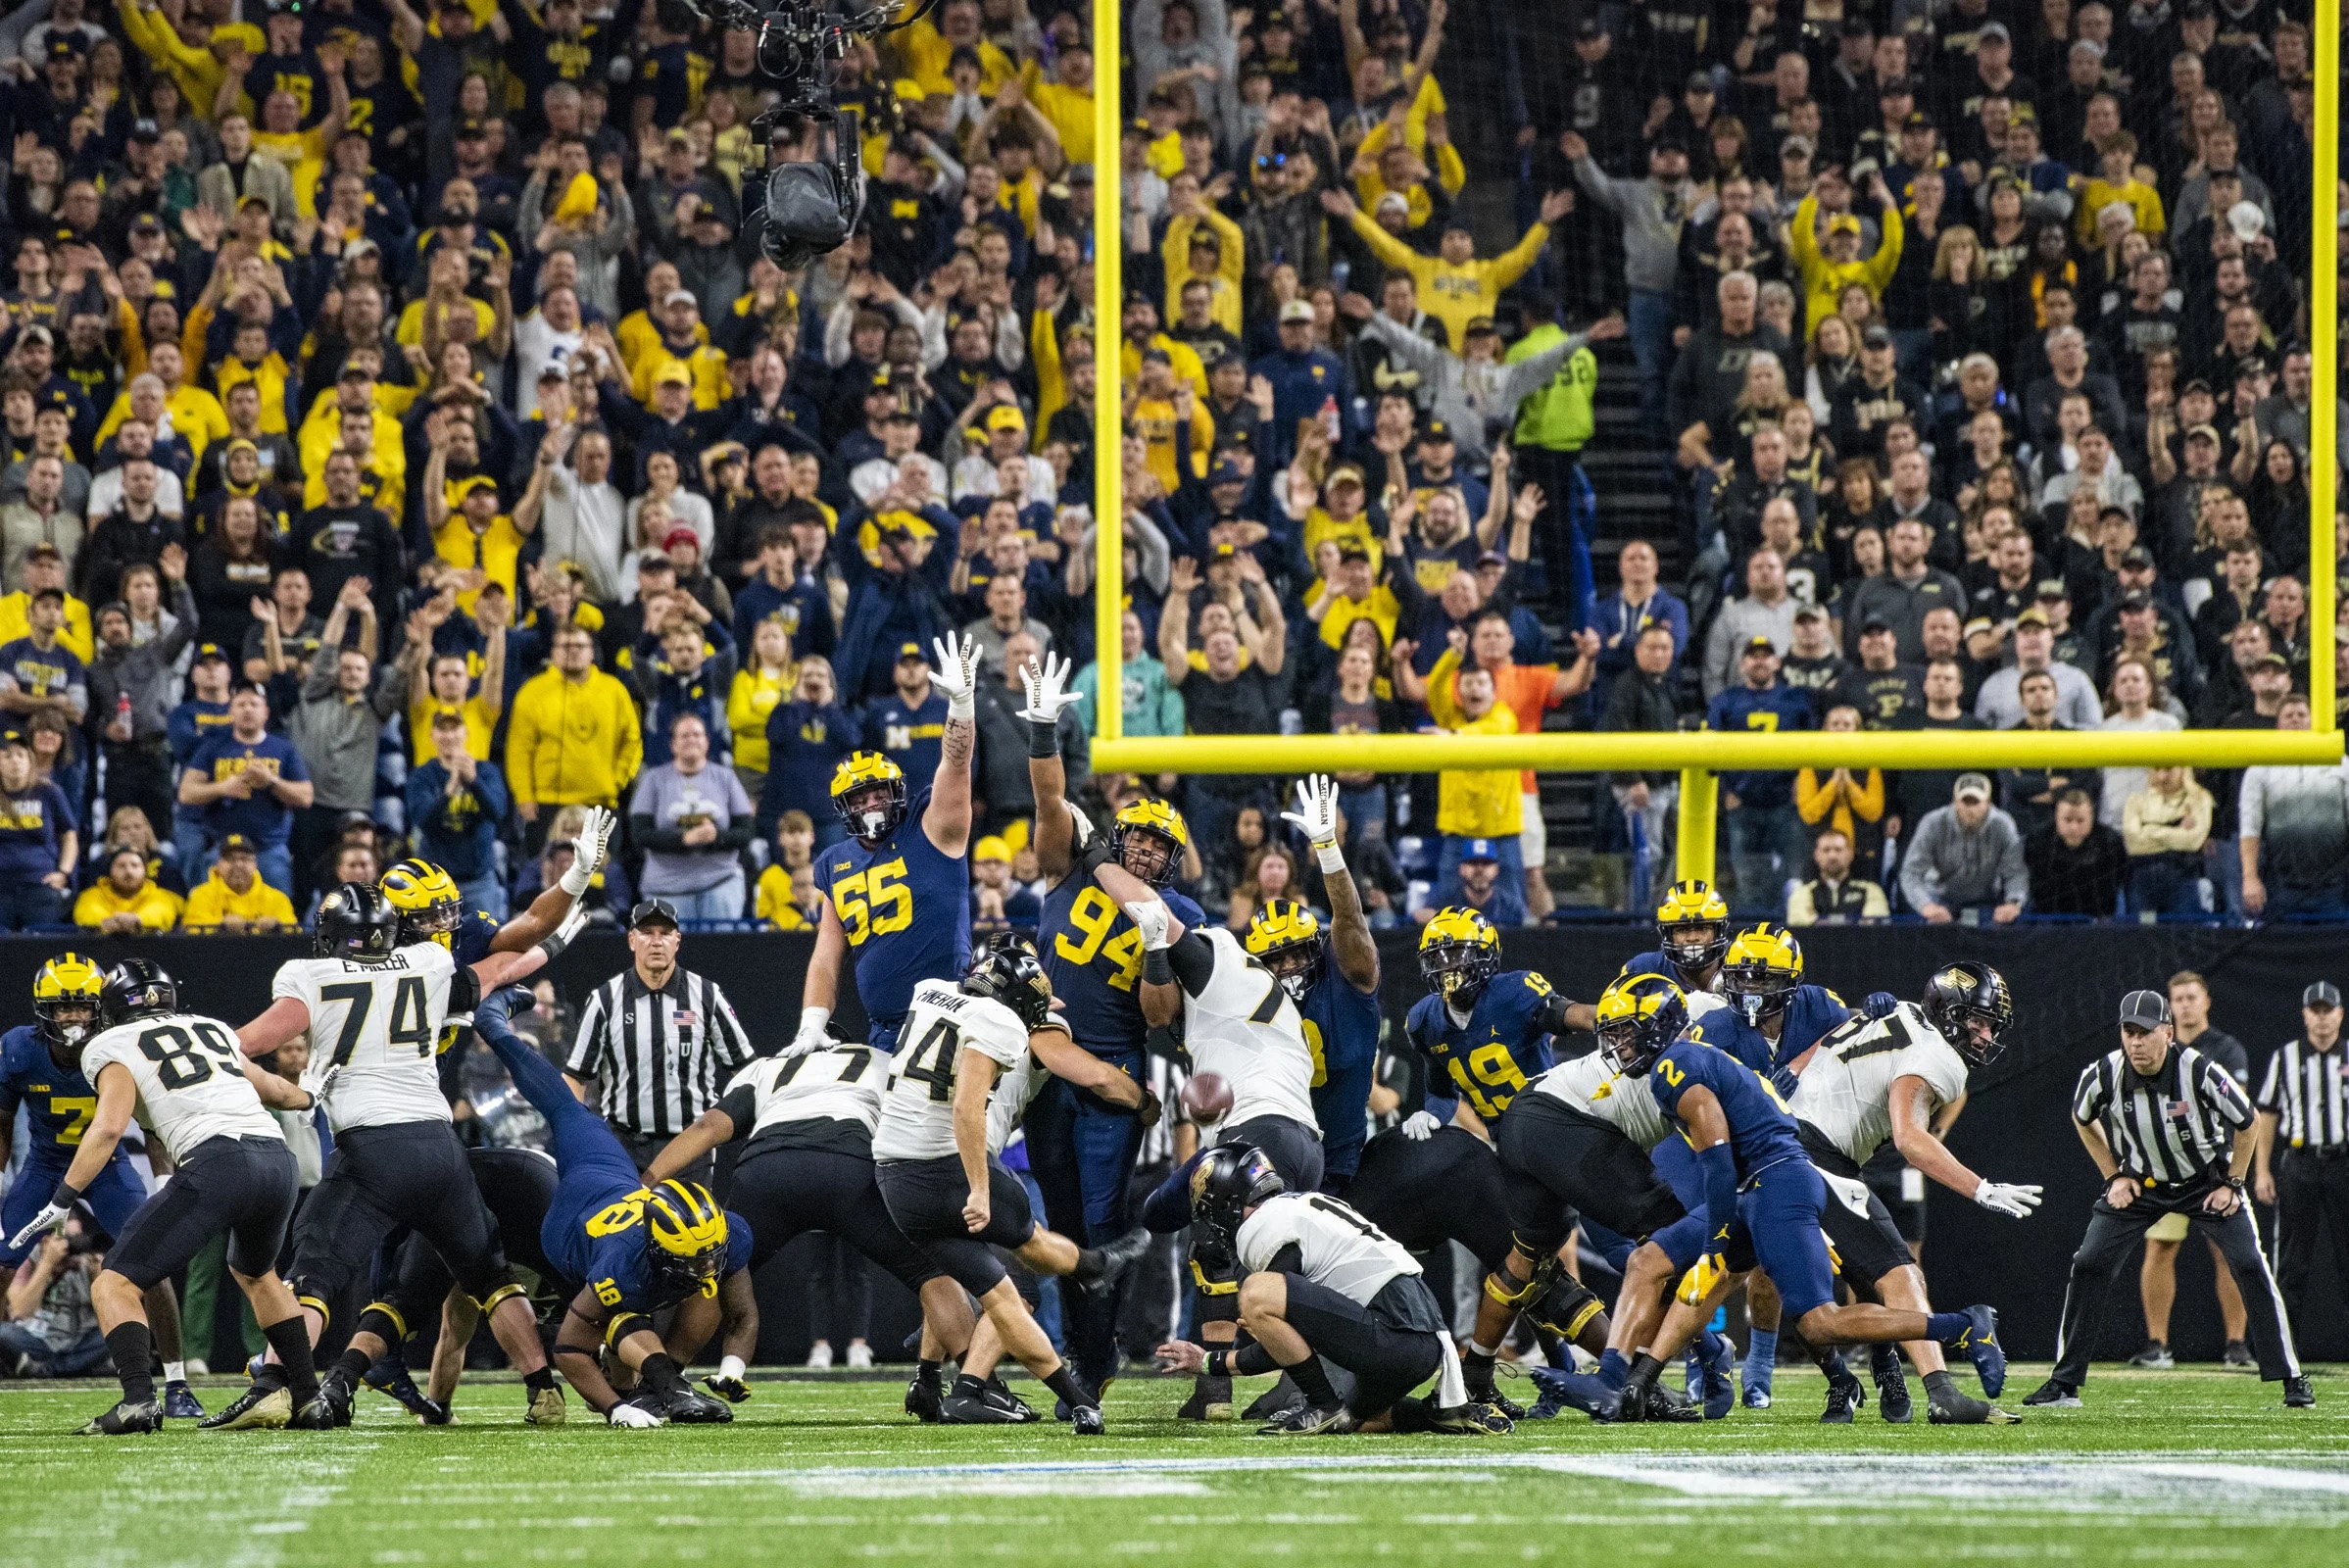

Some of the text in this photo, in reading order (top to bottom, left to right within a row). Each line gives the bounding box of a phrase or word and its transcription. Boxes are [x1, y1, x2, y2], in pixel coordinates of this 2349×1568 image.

[959, 643, 972, 687] MICHIGAN
[1029, 662, 1042, 709] MICHIGAN
[886, 725, 912, 750] M
[1319, 782, 1329, 826] MICHIGAN
[832, 856, 913, 947] 55
[1054, 885, 1145, 992] 94
[342, 960, 357, 973] E.
[1934, 967, 1978, 990] P
[320, 976, 431, 1067] 74
[625, 1012, 635, 1025] S
[137, 1022, 247, 1092] 89
[680, 1042, 692, 1057] U
[1447, 1042, 1529, 1117] 19
[1657, 1058, 1686, 1088] 2
[51, 1097, 96, 1146] 7
[2124, 1101, 2133, 1112] S
[2179, 1129, 2192, 1142] S
[594, 1277, 623, 1307] 18
